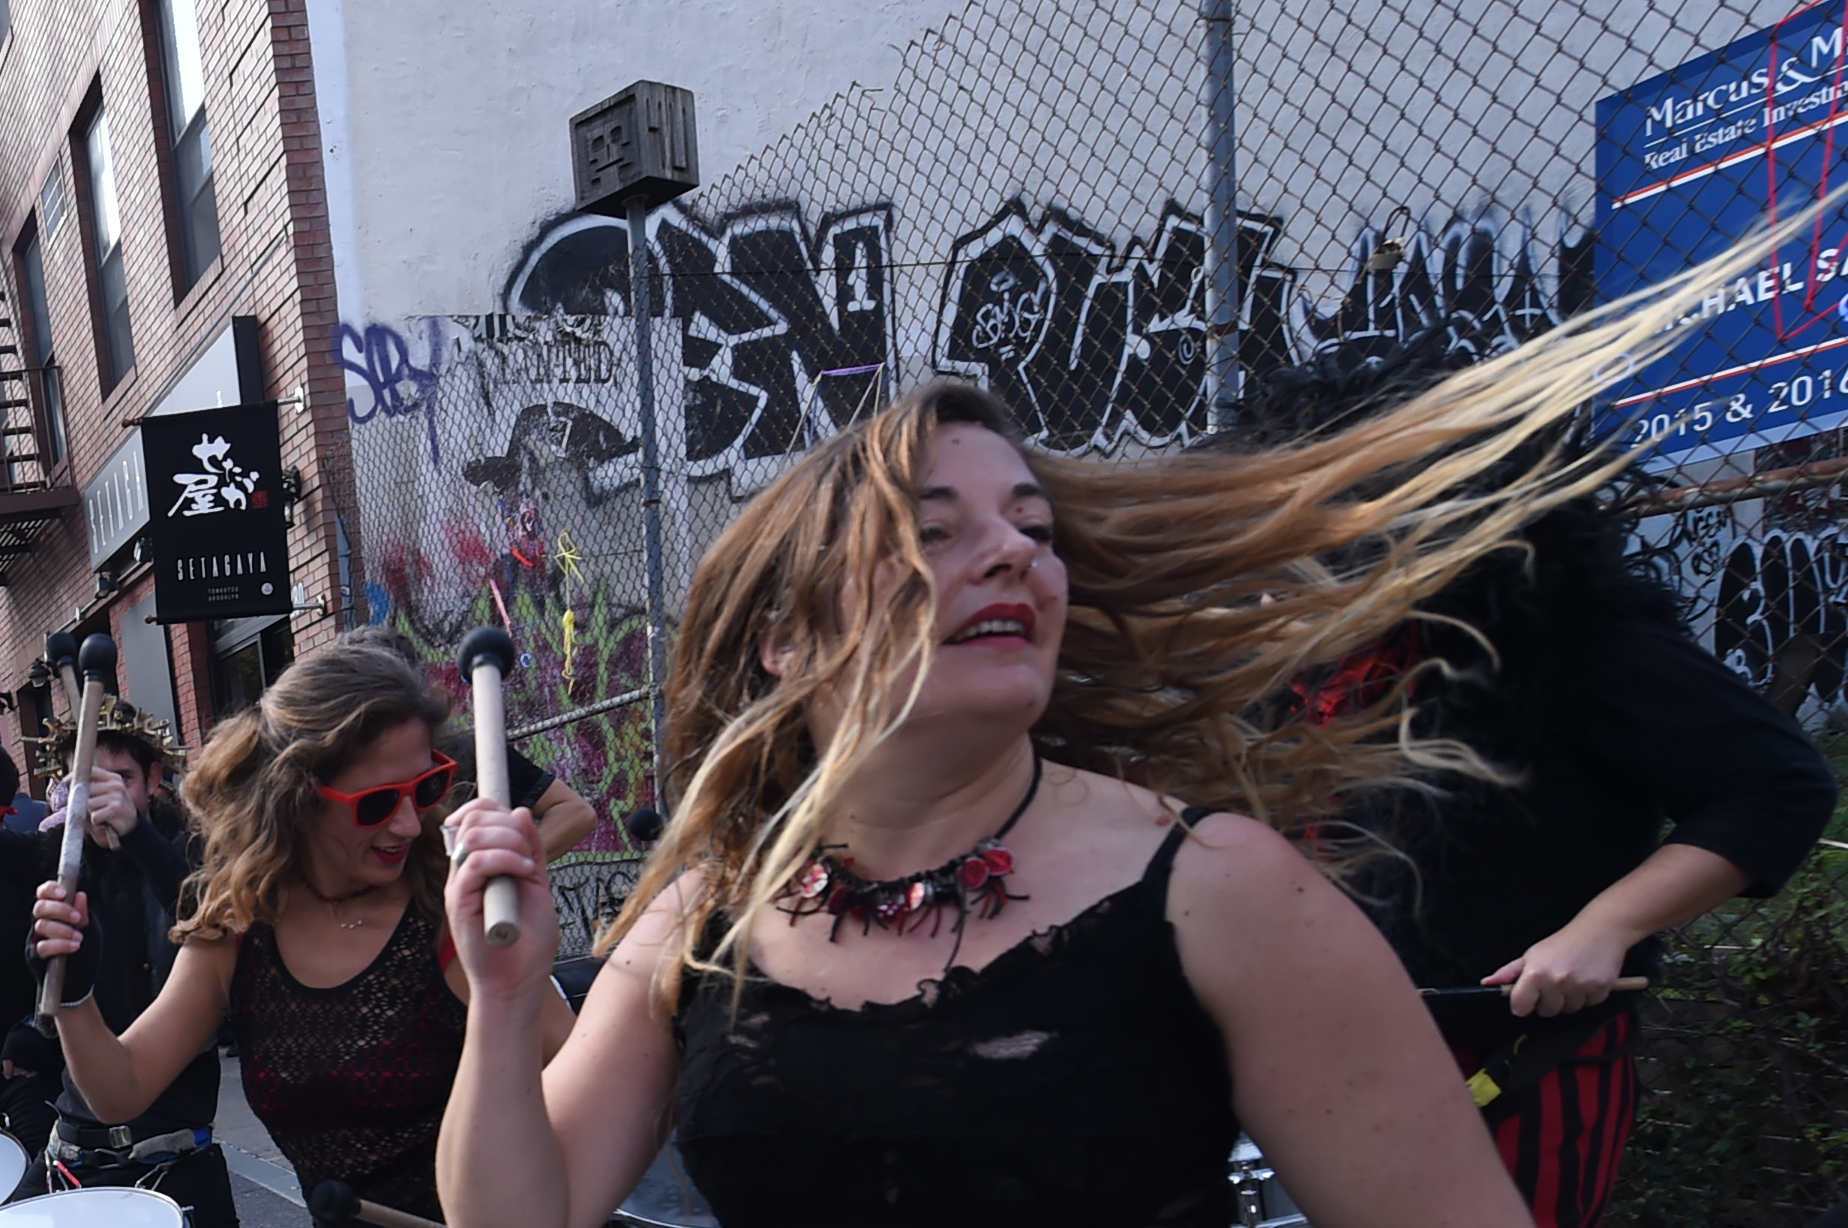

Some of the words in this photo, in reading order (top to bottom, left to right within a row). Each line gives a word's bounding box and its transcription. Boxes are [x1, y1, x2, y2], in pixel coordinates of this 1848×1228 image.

[1645, 68, 1770, 136] Marcus
[1644, 139, 1689, 170] Real
[1695, 118, 1757, 153] Estate
[1631, 402, 1713, 449] 2015
[176, 551, 268, 581] SETAGAYA
